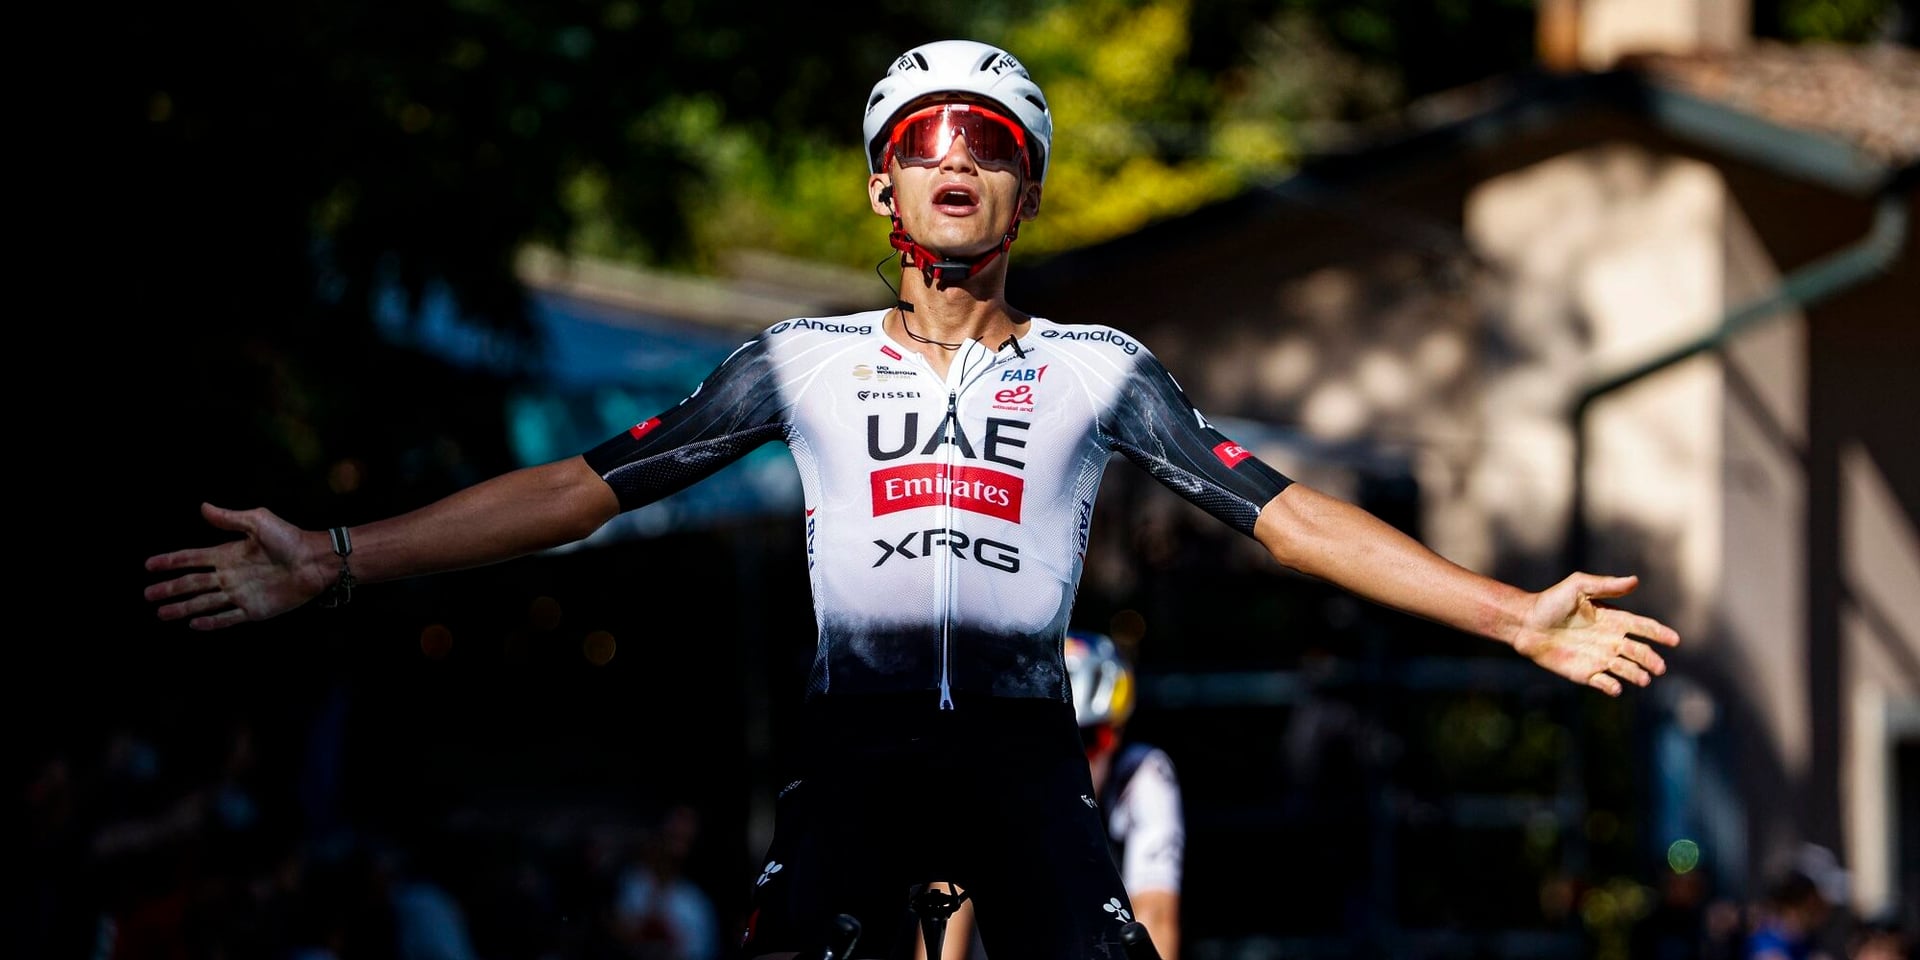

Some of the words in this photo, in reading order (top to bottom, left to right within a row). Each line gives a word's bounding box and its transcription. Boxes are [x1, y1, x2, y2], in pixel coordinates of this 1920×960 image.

[792, 318, 872, 335] Analog
[1060, 330, 1139, 355] Analog
[872, 391, 921, 399] PISSEI
[867, 412, 1031, 470] UAE
[884, 473, 1010, 508] Emirates
[872, 527, 1021, 574] XRG
